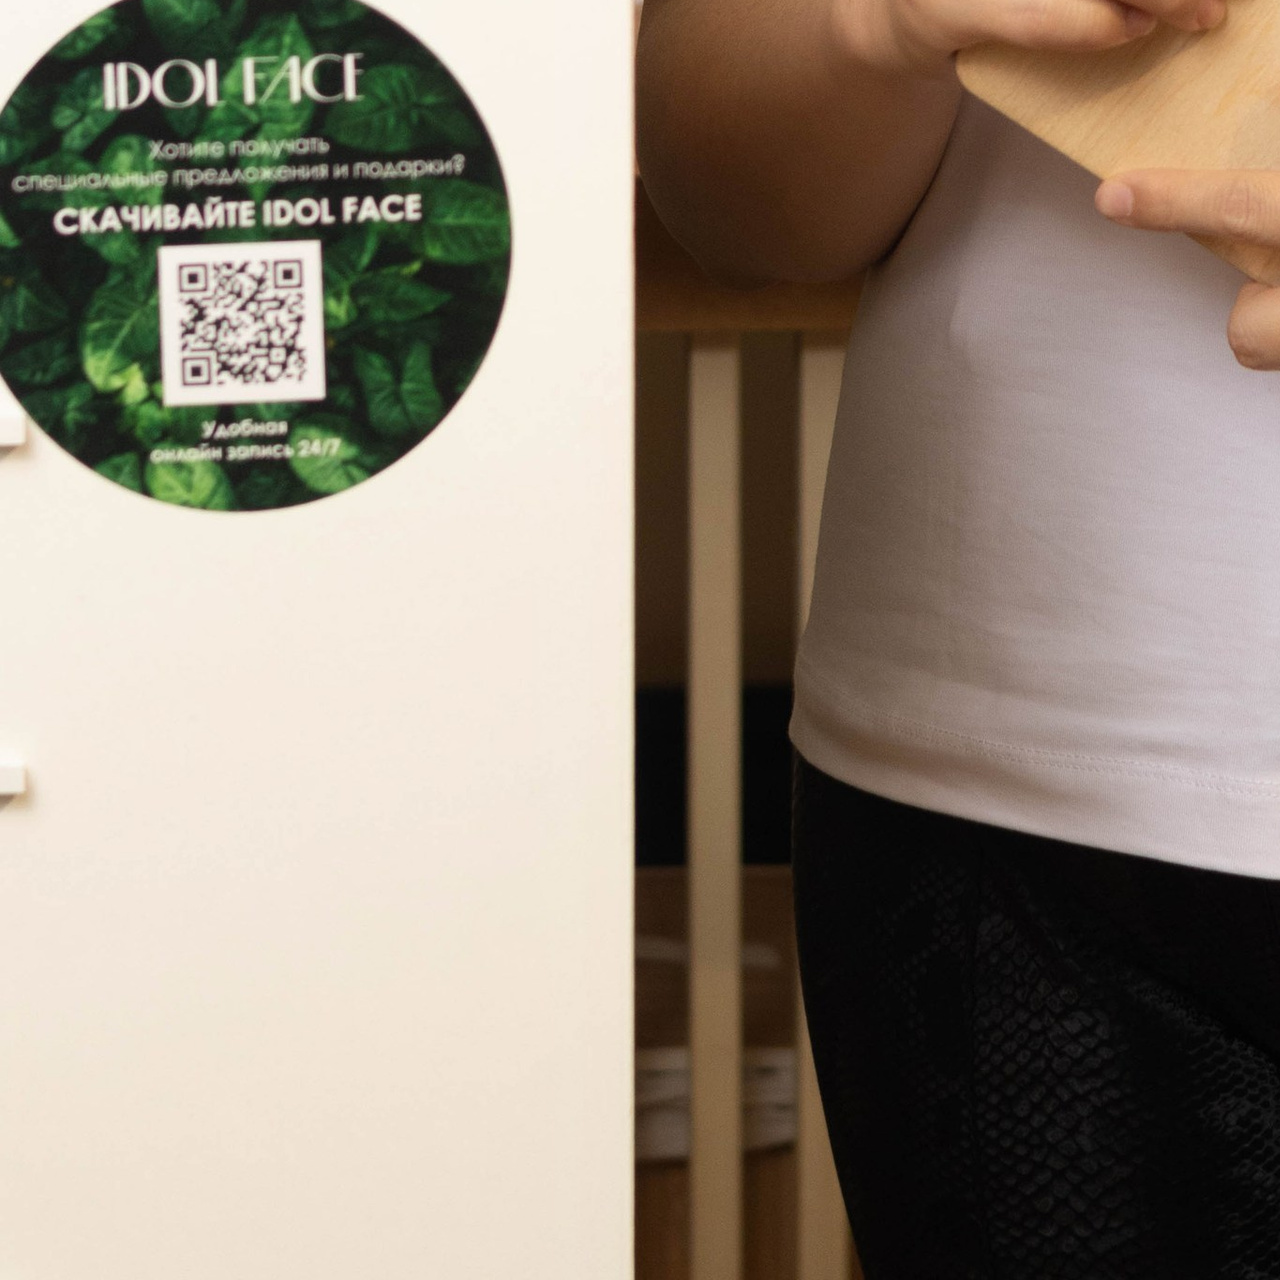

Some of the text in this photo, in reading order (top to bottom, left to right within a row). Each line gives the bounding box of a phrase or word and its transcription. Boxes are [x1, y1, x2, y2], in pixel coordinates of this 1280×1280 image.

[103, 52, 364, 111] IDOL FACE
[149, 137, 330, 160] Хотите получать
[11, 153, 465, 192] специальные предложения и подарки?
[53, 193, 422, 235] СКАЧИВАЙТЕ IDOL FACE
[202, 418, 288, 439] Удобная
[150, 437, 341, 464] онлайн запись 24/7
